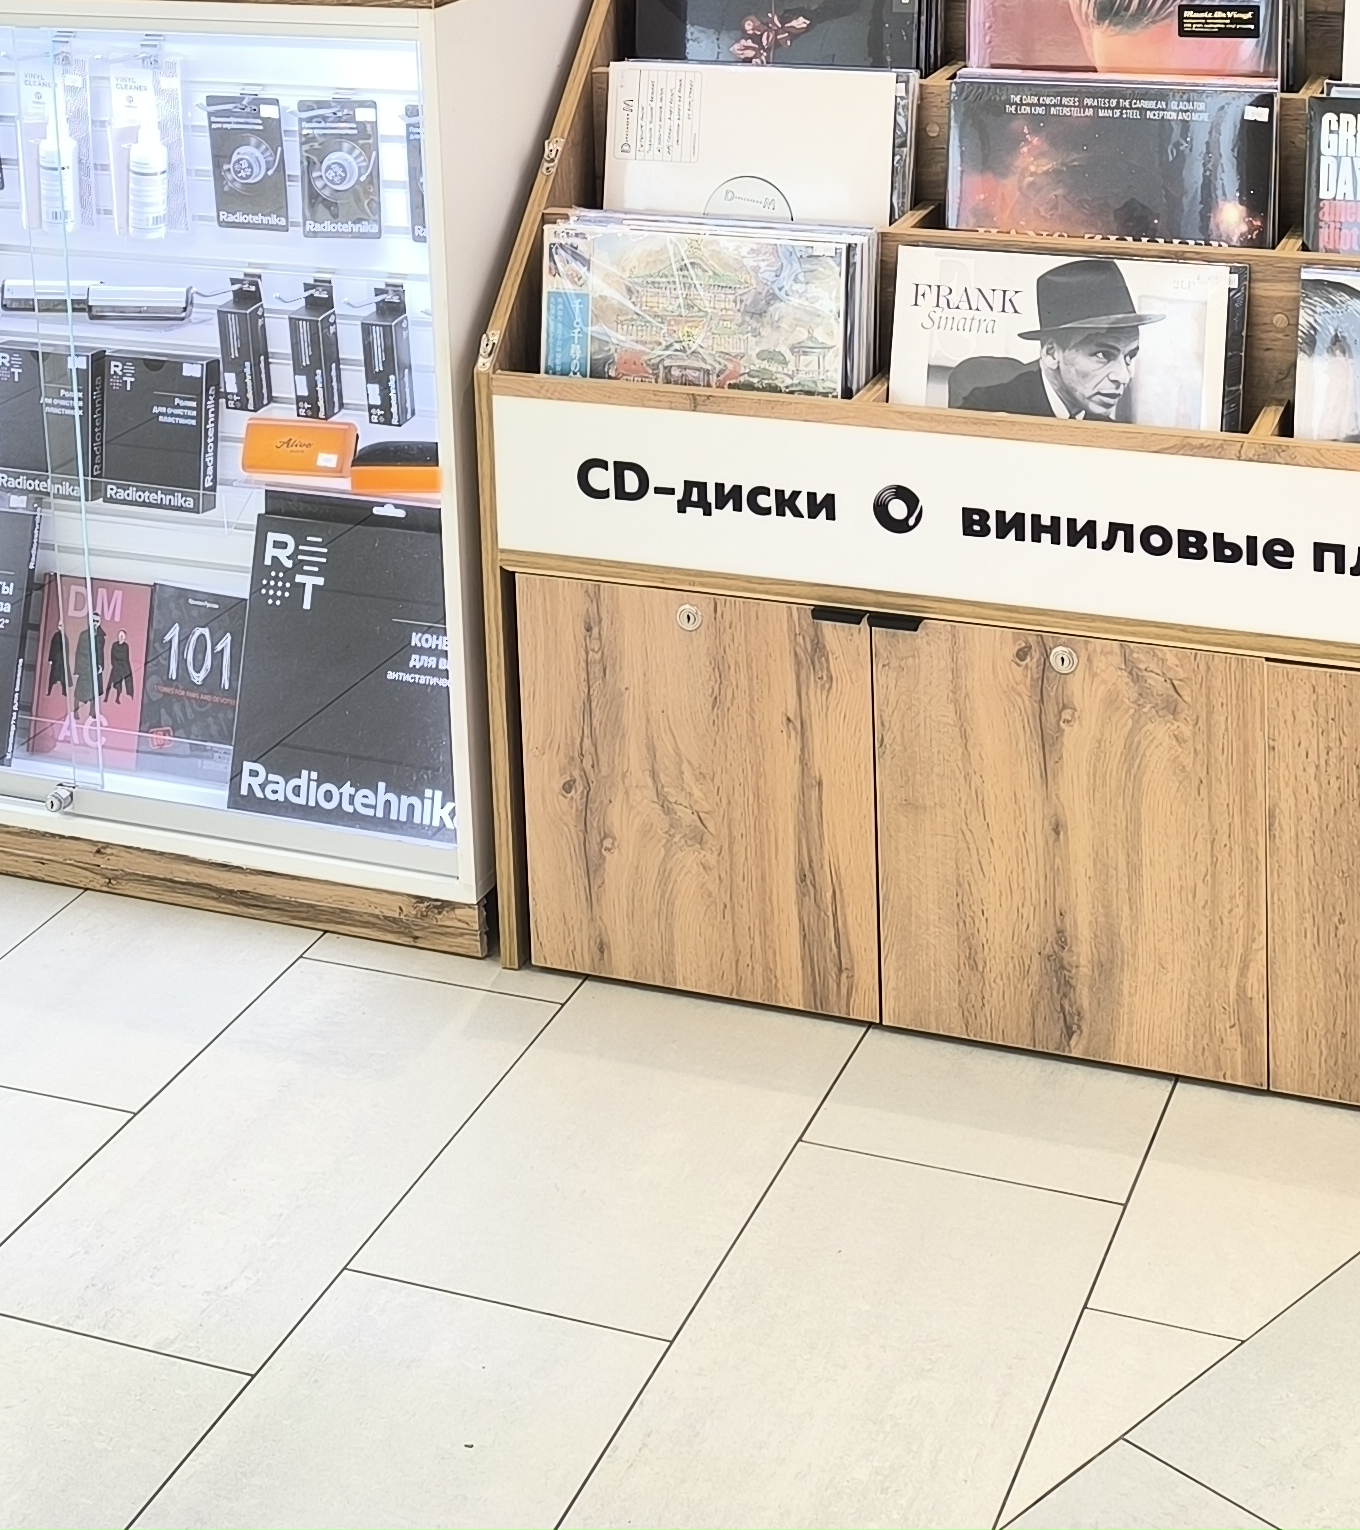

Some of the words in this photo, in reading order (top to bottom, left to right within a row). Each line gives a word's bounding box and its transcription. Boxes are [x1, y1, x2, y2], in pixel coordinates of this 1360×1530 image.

[23, 72, 43, 81] VINYL
[115, 76, 136, 84] VINYL
[115, 83, 148, 92] CLEANER
[1005, 105, 1017, 113] THE
[1017, 105, 1031, 114] LION
[1031, 106, 1046, 115] KING
[1050, 106, 1094, 117] INTERSTELLAR
[1099, 107, 1113, 117] MAN
[1114, 108, 1121, 117] OF
[1122, 109, 1141, 118] STEEL
[1010, 95, 1021, 103] THE
[1022, 95, 1039, 104] DARK
[1039, 95, 1061, 105] KNIGHT
[1061, 96, 1079, 106] RISES
[1084, 97, 1110, 107] PIRATES
[1110, 98, 1117, 108] OF
[1119, 99, 1131, 108] THE
[219, 210, 287, 226] Radiotehnika
[305, 220, 379, 234] Radiotehnika
[1318, 222, 1360, 253] idiot
[1172, 277, 1196, 291] 2LP
[910, 282, 1023, 316] FRANK
[920, 308, 998, 335] Sinatra
[93, 375, 103, 476] Radiotehnika
[204, 386, 216, 488] Radiotehnika
[107, 484, 194, 508] Radiotehnika
[575, 459, 839, 522] CD-диски
[960, 498, 1296, 572] виниловые
[162, 622, 232, 691] 101
[408, 653, 436, 669] для
[239, 760, 457, 830] Radiotehnik
